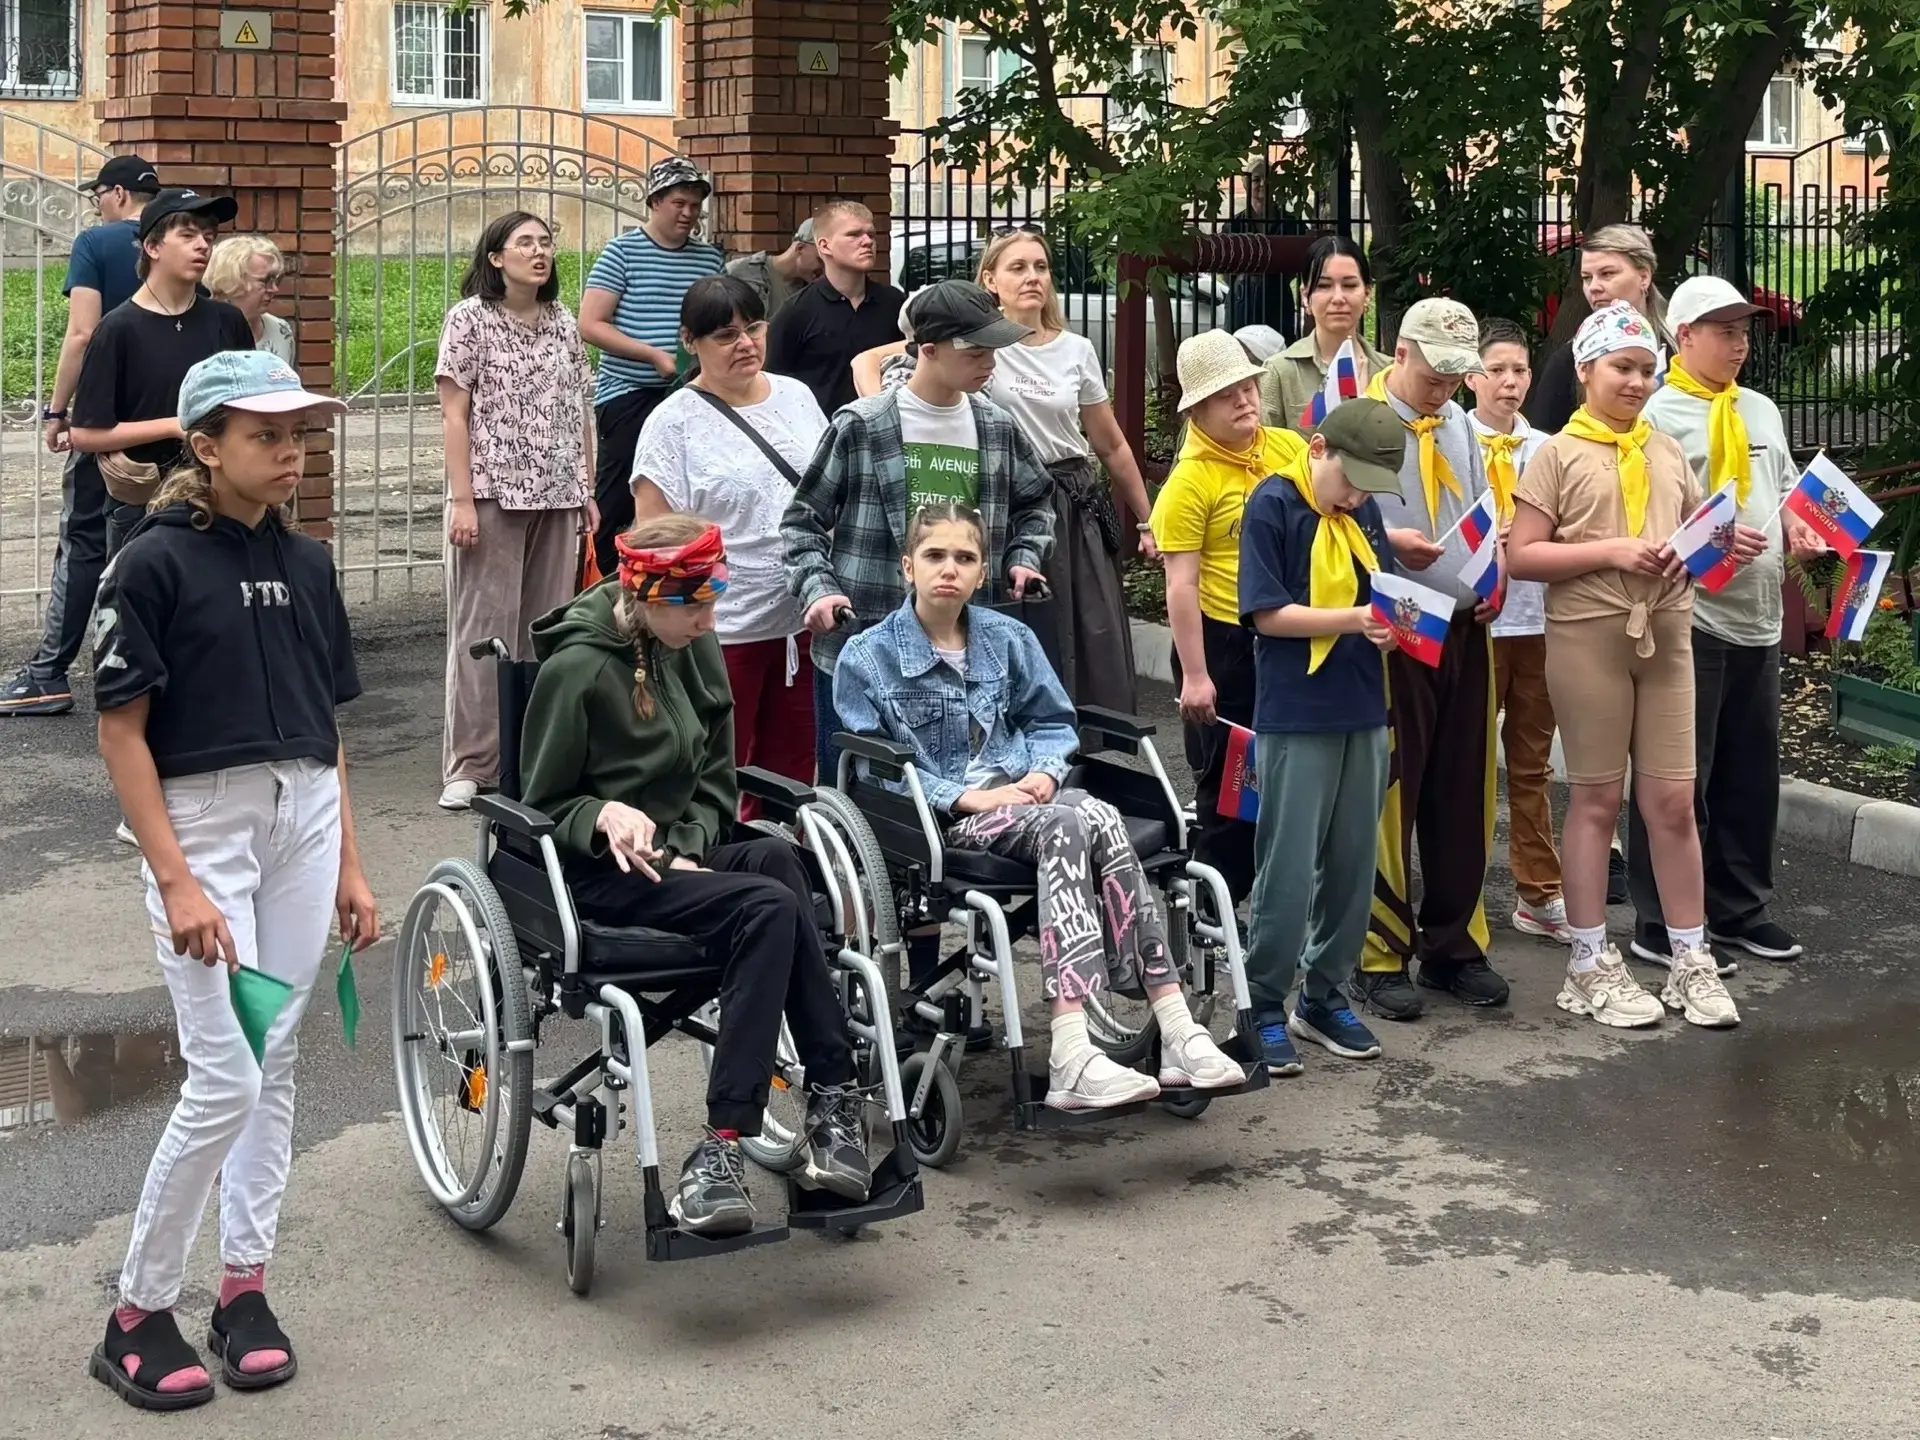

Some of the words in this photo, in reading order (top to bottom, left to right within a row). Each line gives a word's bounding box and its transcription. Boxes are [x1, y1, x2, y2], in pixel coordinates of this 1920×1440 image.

[903, 455, 922, 470] 5th
[929, 456, 980, 474] AVENUE
[910, 491, 947, 505] STATE
[1804, 500, 1839, 533] РОССИЯ
